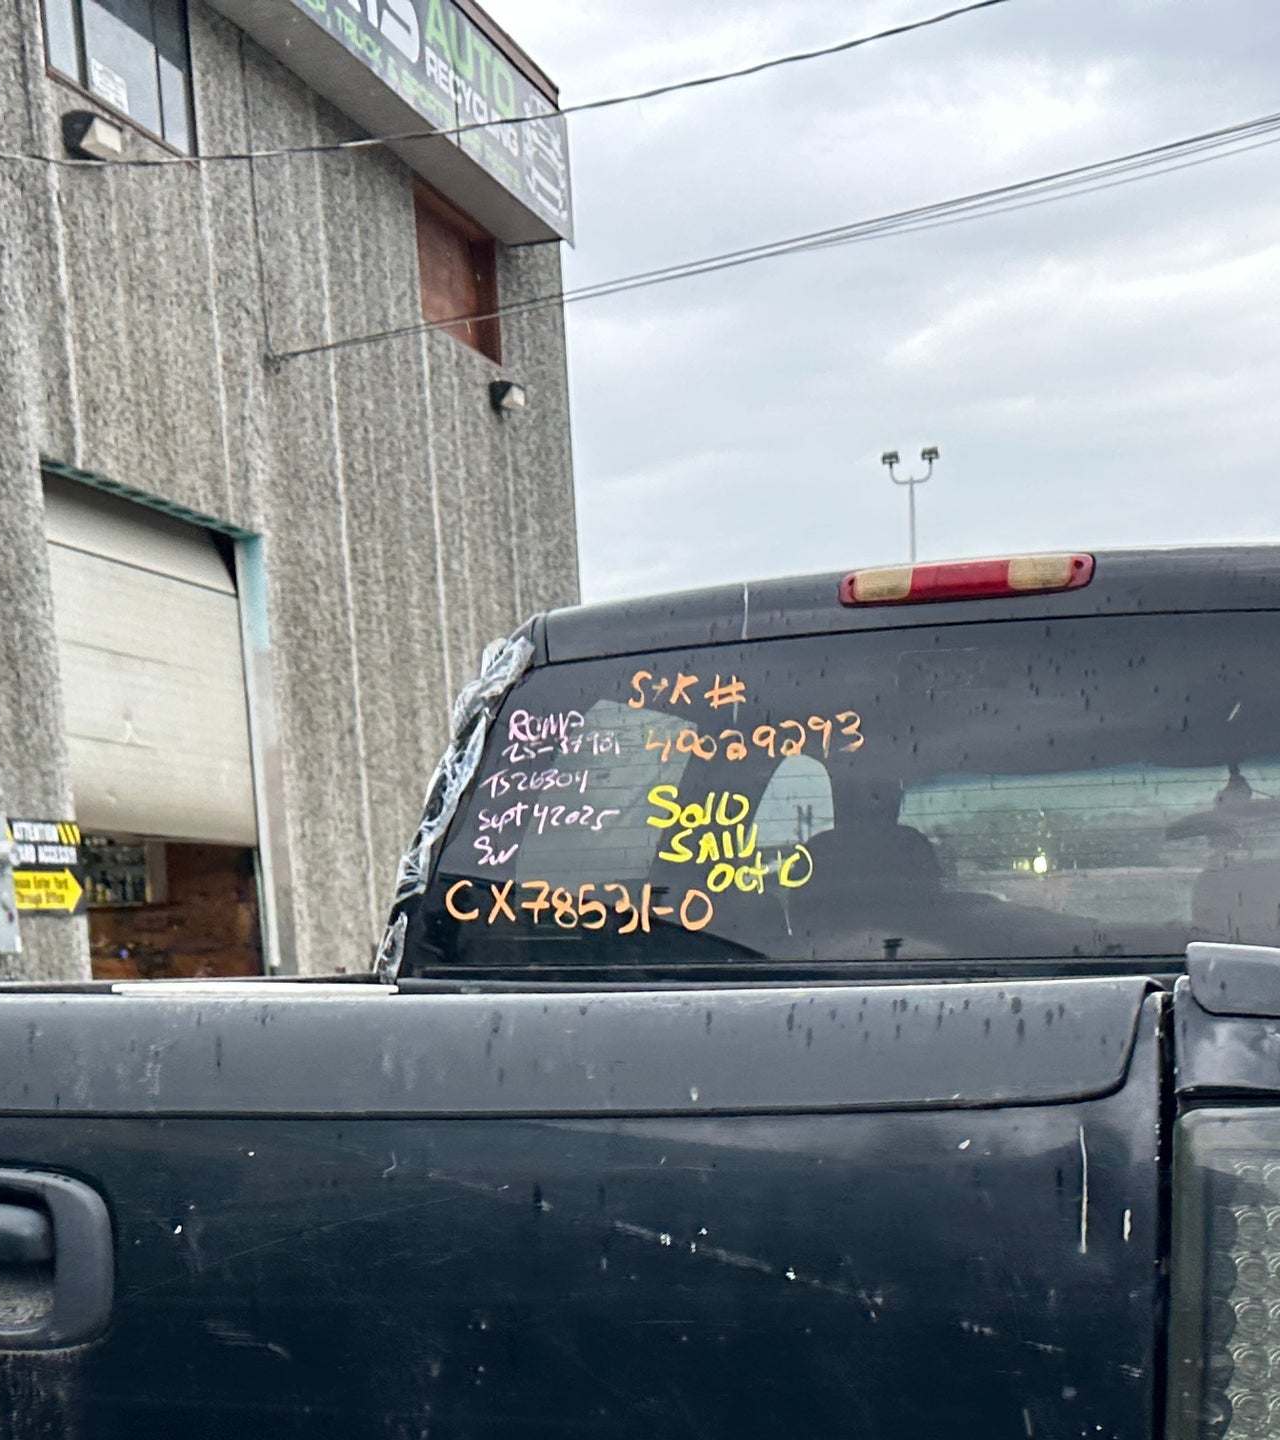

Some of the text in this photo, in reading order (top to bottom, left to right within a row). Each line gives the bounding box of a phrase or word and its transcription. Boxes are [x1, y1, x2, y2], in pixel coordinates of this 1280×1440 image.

[425, 0, 516, 121] AUTO
[425, 46, 519, 157] RECYCLING
[704, 673, 747, 710] #
